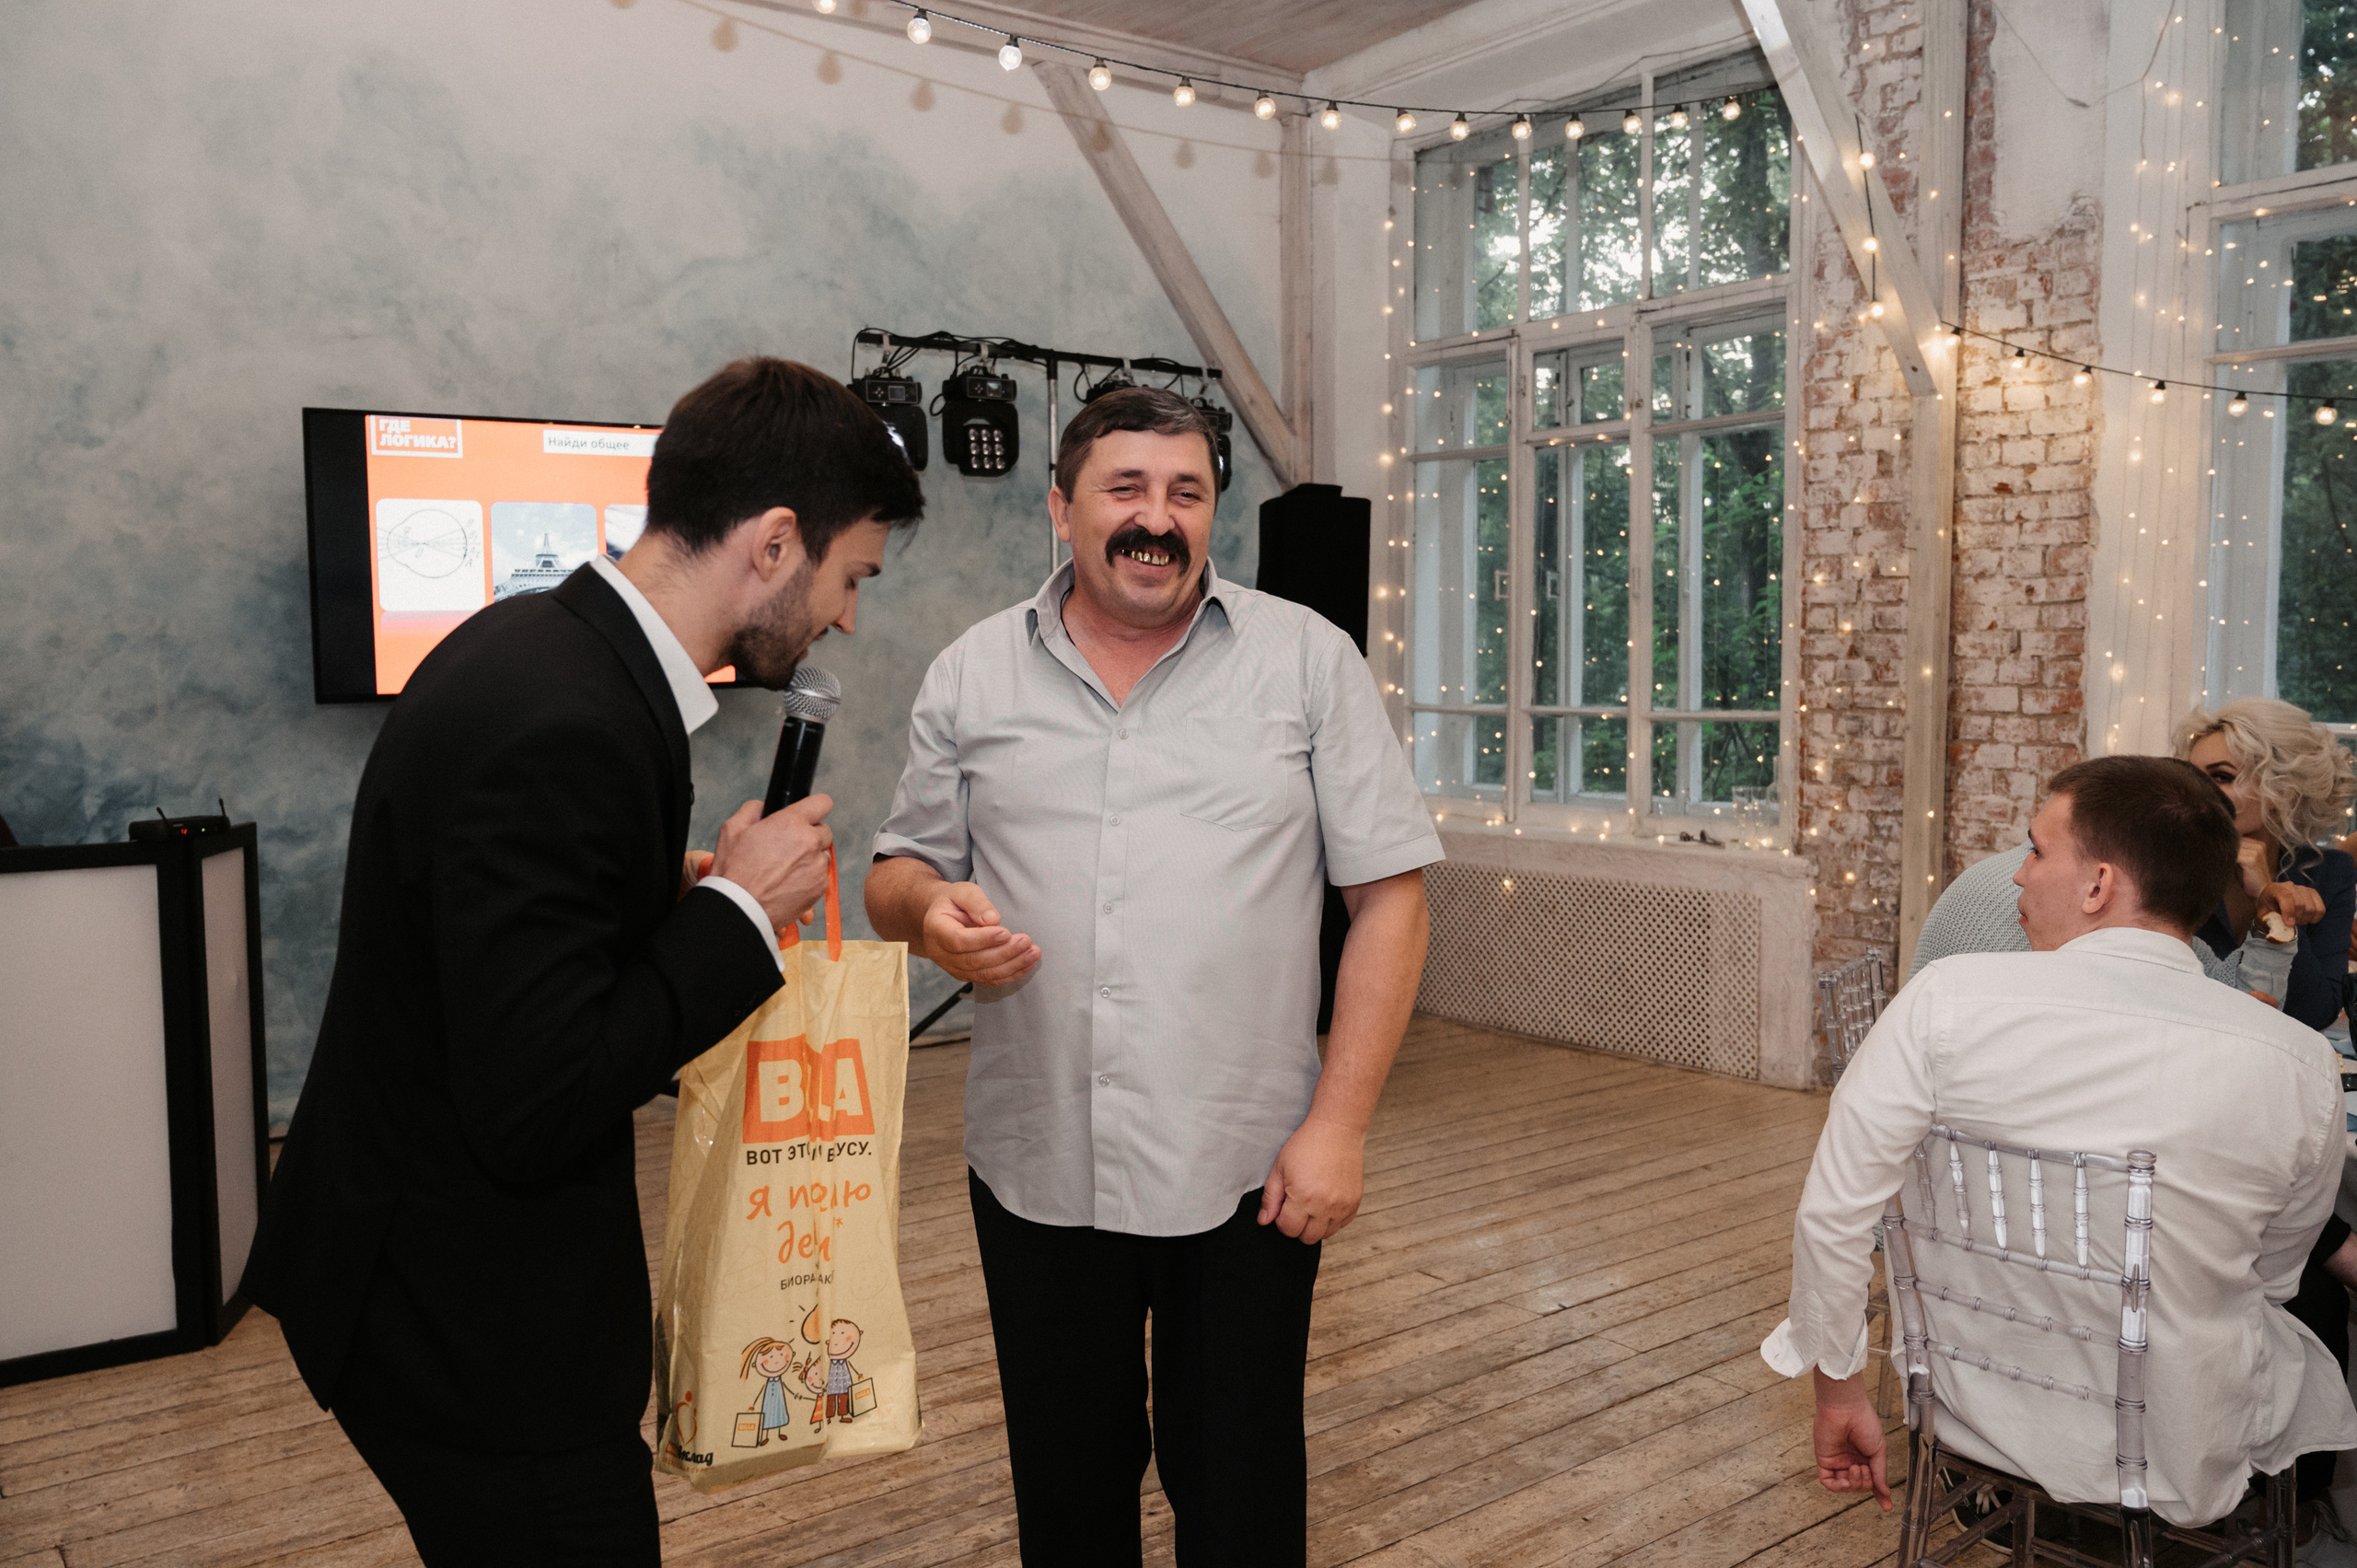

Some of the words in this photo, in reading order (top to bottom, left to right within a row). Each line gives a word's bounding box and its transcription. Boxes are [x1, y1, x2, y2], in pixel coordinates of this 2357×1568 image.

[378, 418, 411, 434] ГДЕ
[379, 434, 457, 449] ЛОГИКА?
[548, 436, 587, 448] Найди
[591, 438, 630, 449] общее
[747, 1148, 783, 1166] ВОТ
